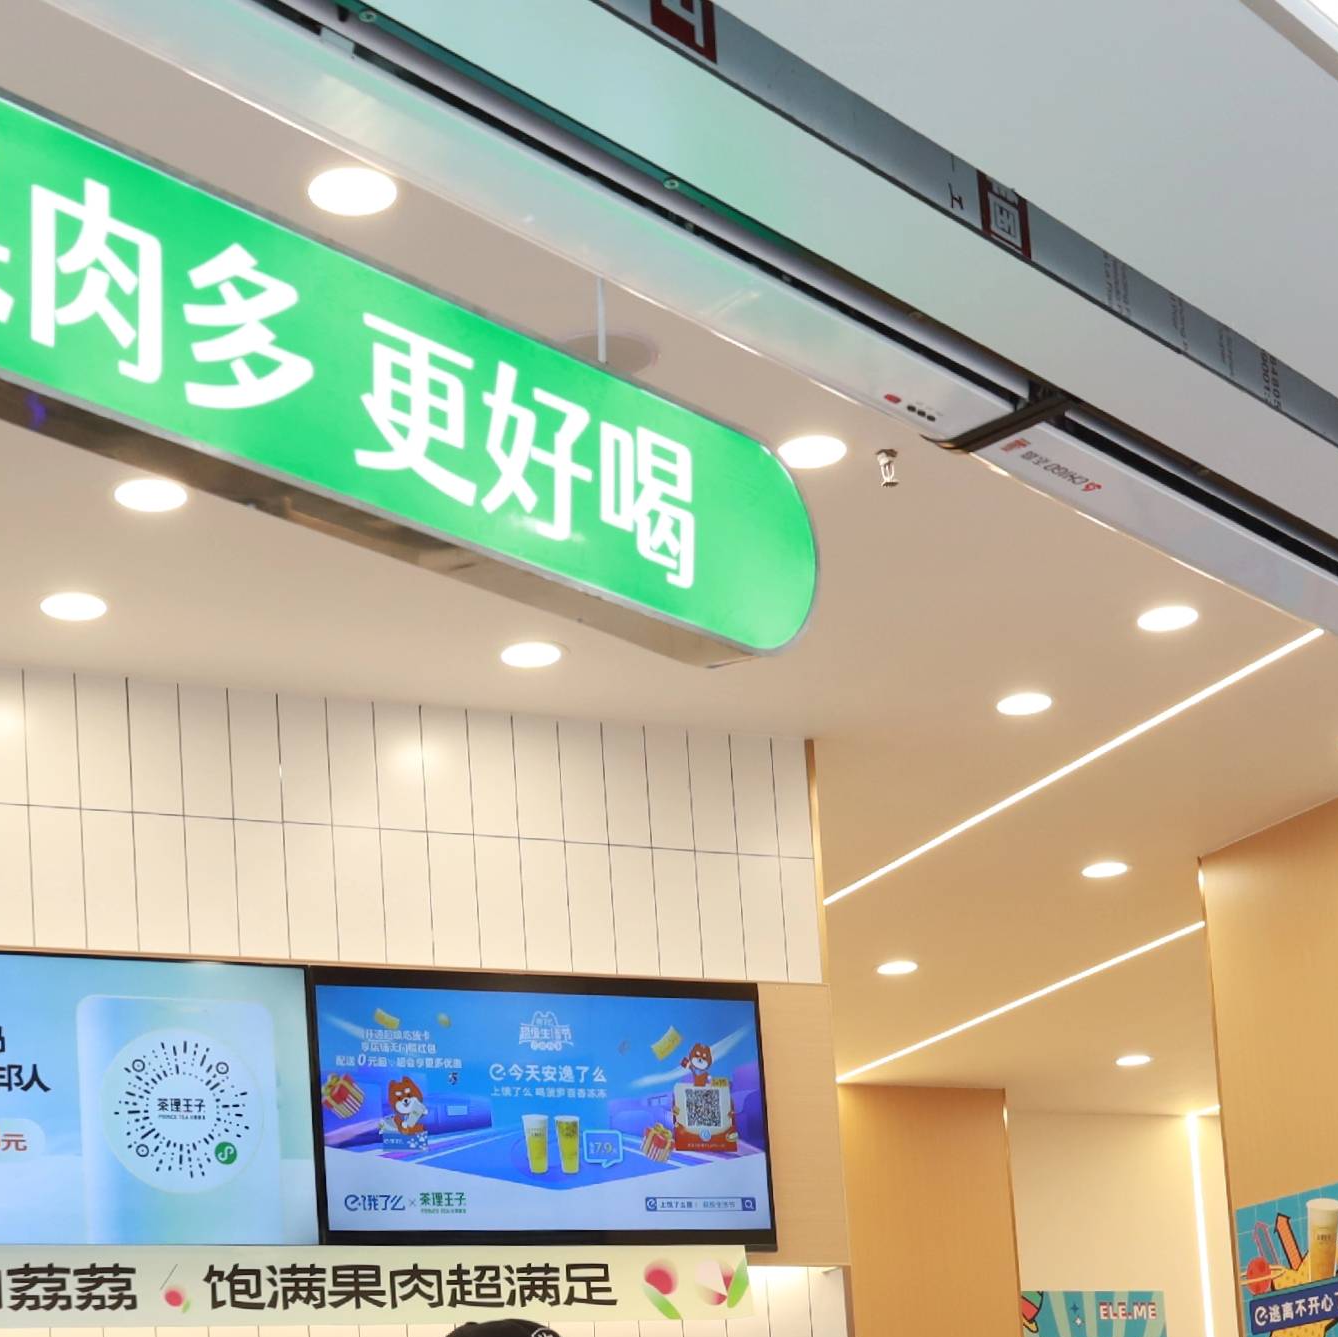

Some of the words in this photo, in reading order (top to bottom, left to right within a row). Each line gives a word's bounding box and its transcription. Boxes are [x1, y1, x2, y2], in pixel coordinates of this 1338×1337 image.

[353, 312, 696, 591] 更好喝
[204, 1262, 618, 1311] 饱满果肉超满足
